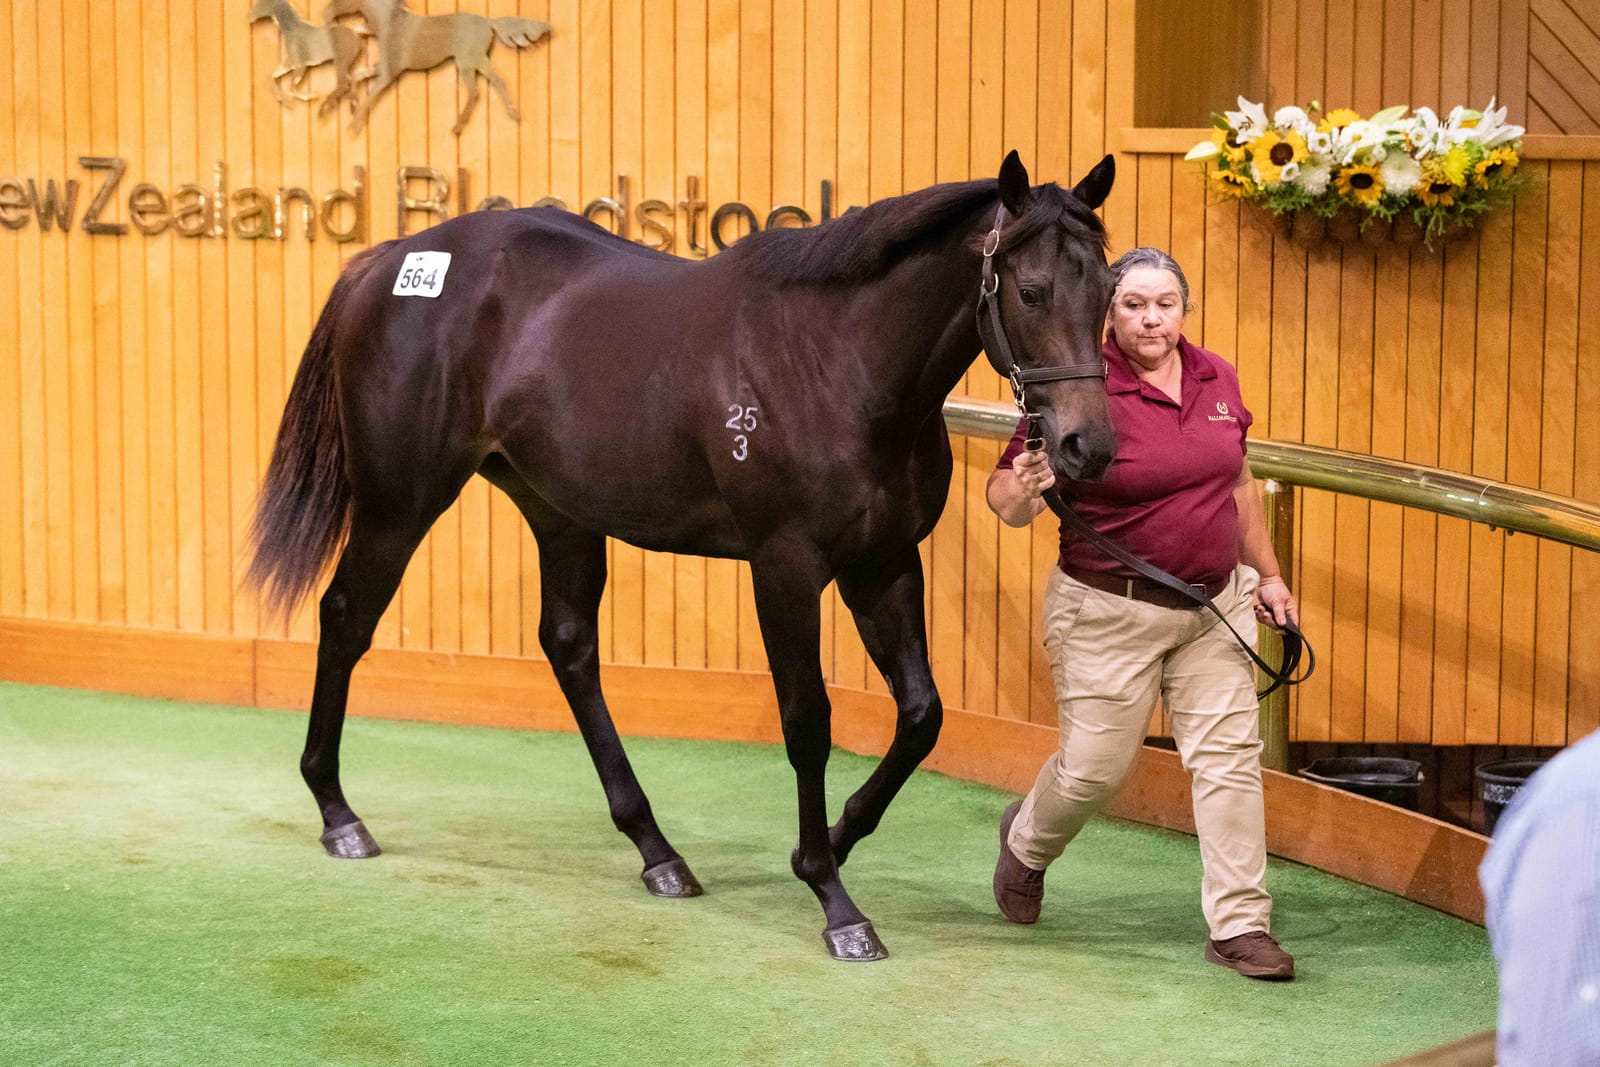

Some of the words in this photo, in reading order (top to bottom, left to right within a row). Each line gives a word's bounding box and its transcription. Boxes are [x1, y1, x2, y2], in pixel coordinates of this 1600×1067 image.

[398, 166, 864, 257] Bldsto
[400, 268, 438, 290] 564
[726, 404, 758, 432] 25
[732, 435, 748, 461] 3
